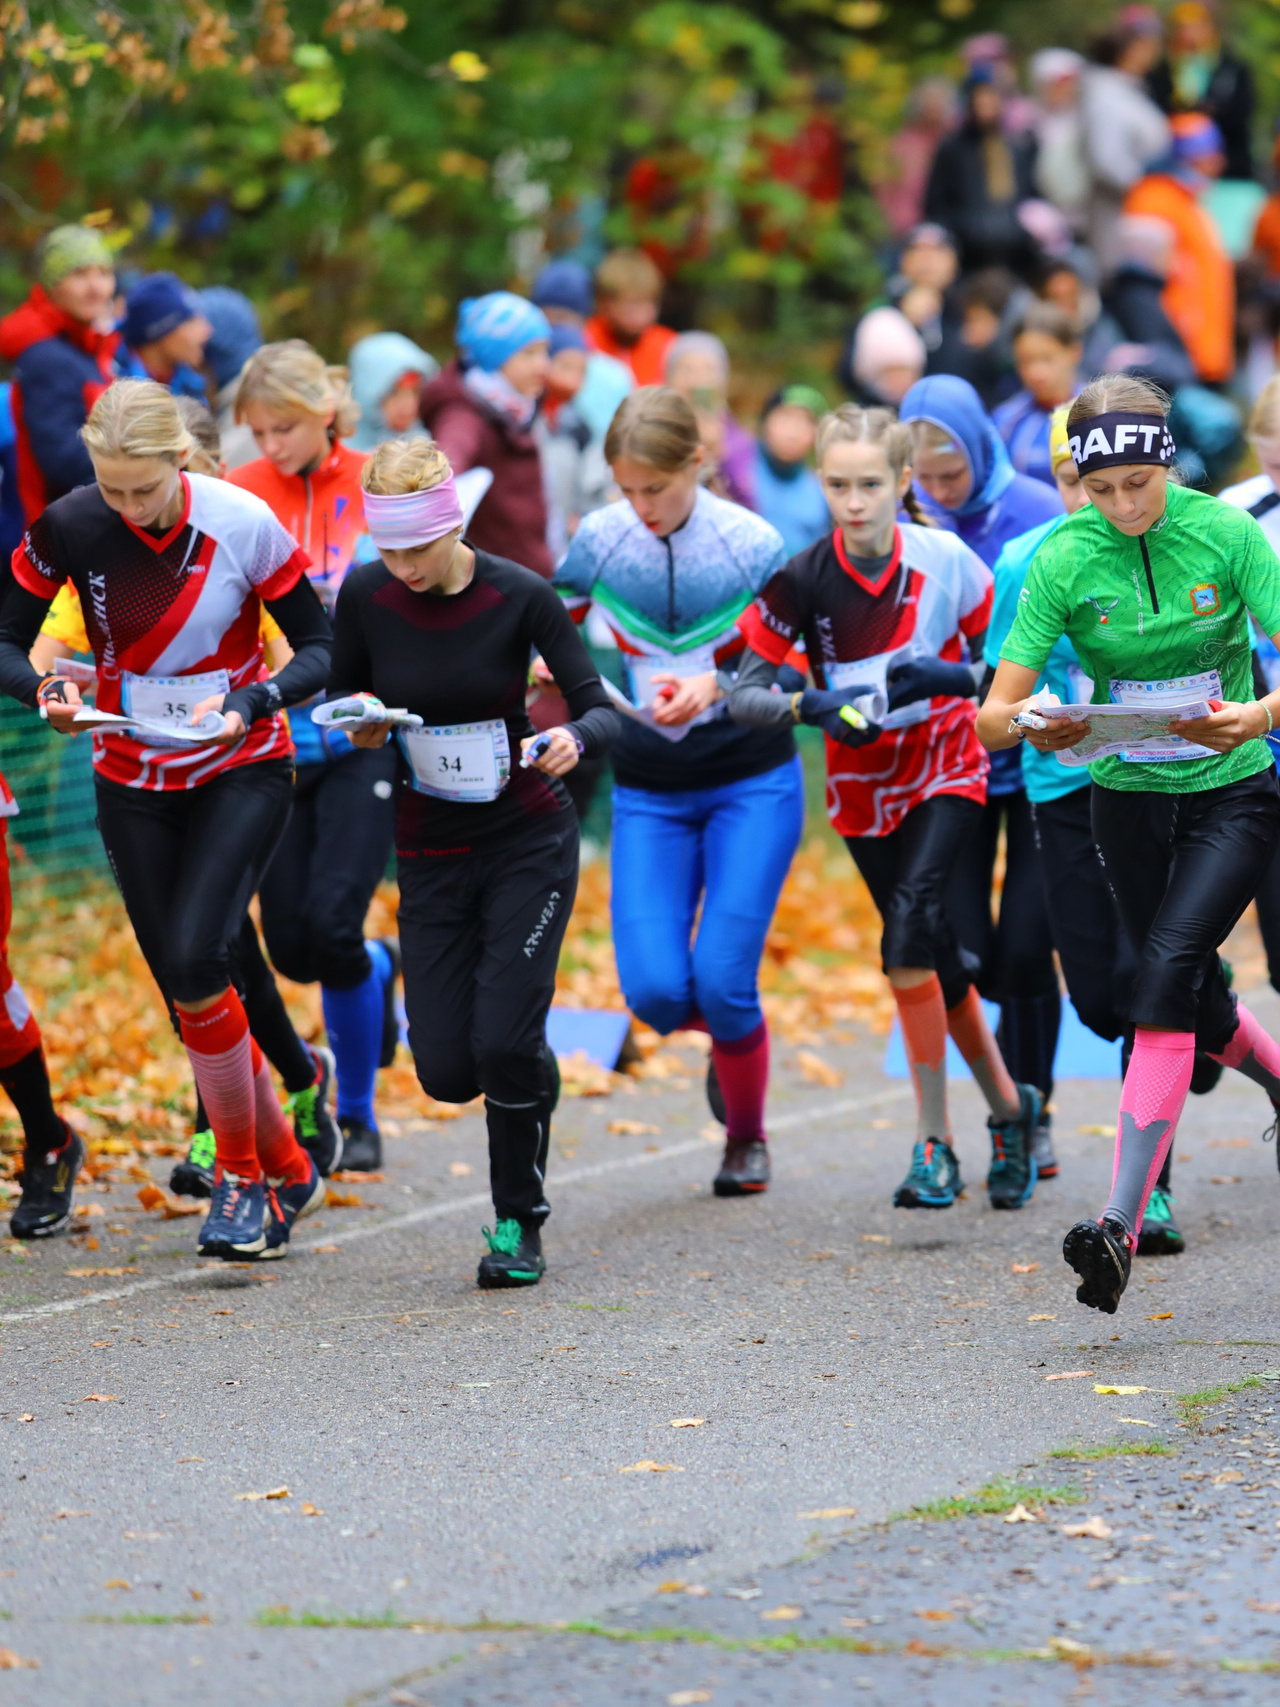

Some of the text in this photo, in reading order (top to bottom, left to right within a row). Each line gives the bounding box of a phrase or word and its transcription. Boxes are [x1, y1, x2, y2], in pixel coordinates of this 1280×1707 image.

[1131, 568, 1143, 608] VICTORY
[1190, 613, 1228, 627] ОРЛОВСКАЯ
[1195, 622, 1225, 633] ОБЛАСТЬ
[162, 702, 187, 718] 35
[438, 755, 462, 773] 34
